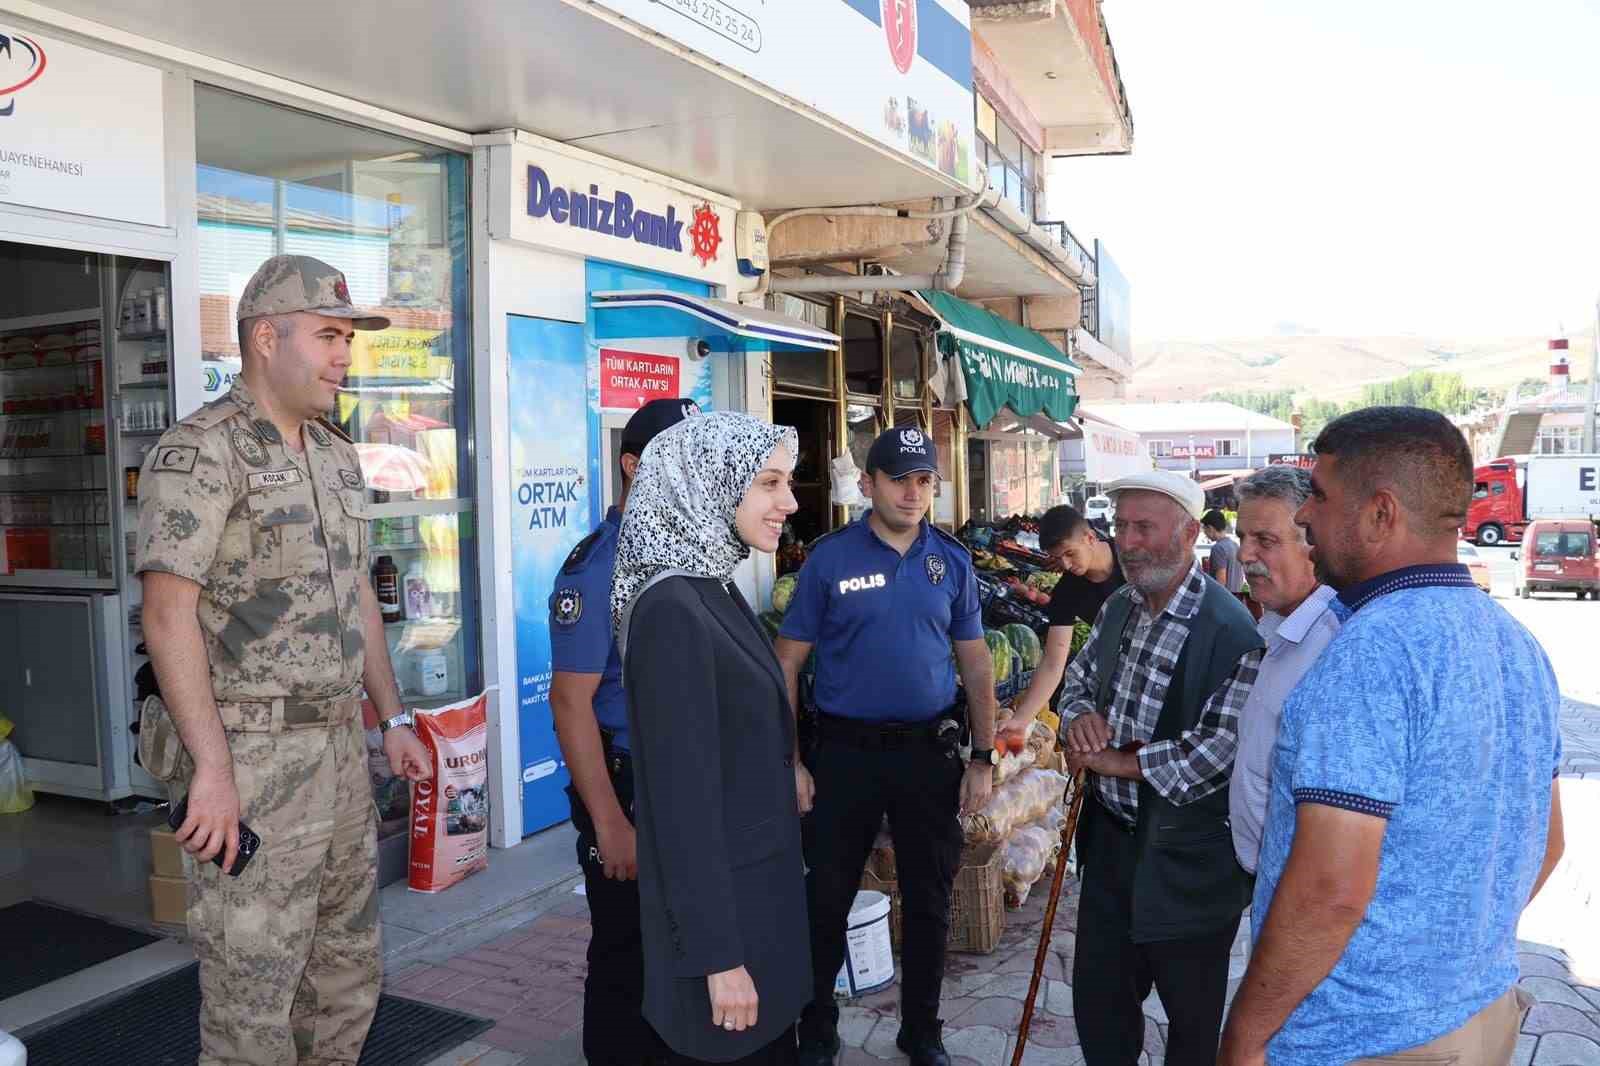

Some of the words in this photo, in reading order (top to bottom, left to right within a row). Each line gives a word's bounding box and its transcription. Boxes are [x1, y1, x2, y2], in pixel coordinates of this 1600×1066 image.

[702, 2, 722, 26] 275
[725, 16, 738, 35] 25
[741, 24, 754, 41] 24
[526, 164, 684, 252] DenizBank
[605, 355, 625, 371] TÜM
[626, 360, 674, 377] KARTLARIN
[610, 375, 640, 389] ORTAK
[518, 481, 577, 505] ORTAK
[529, 506, 566, 530] ATM
